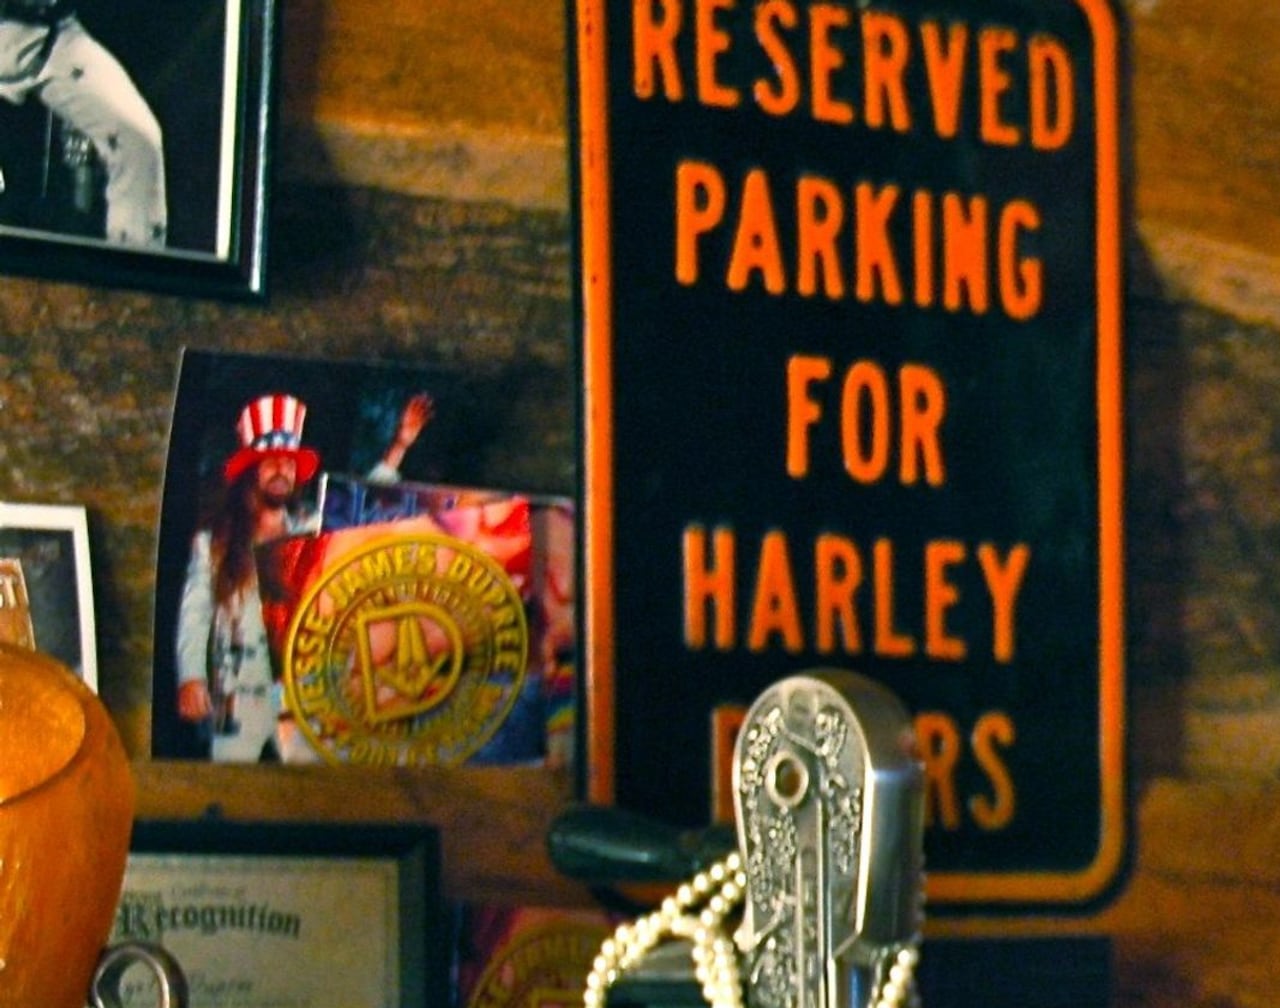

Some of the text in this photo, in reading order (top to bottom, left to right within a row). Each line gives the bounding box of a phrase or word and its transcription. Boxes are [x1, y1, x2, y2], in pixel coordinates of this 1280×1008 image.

[633, 0, 1075, 149] RESERVED
[676, 159, 1042, 319] PARKING
[787, 354, 945, 486] FOR
[683, 523, 1030, 661] HARLEY
